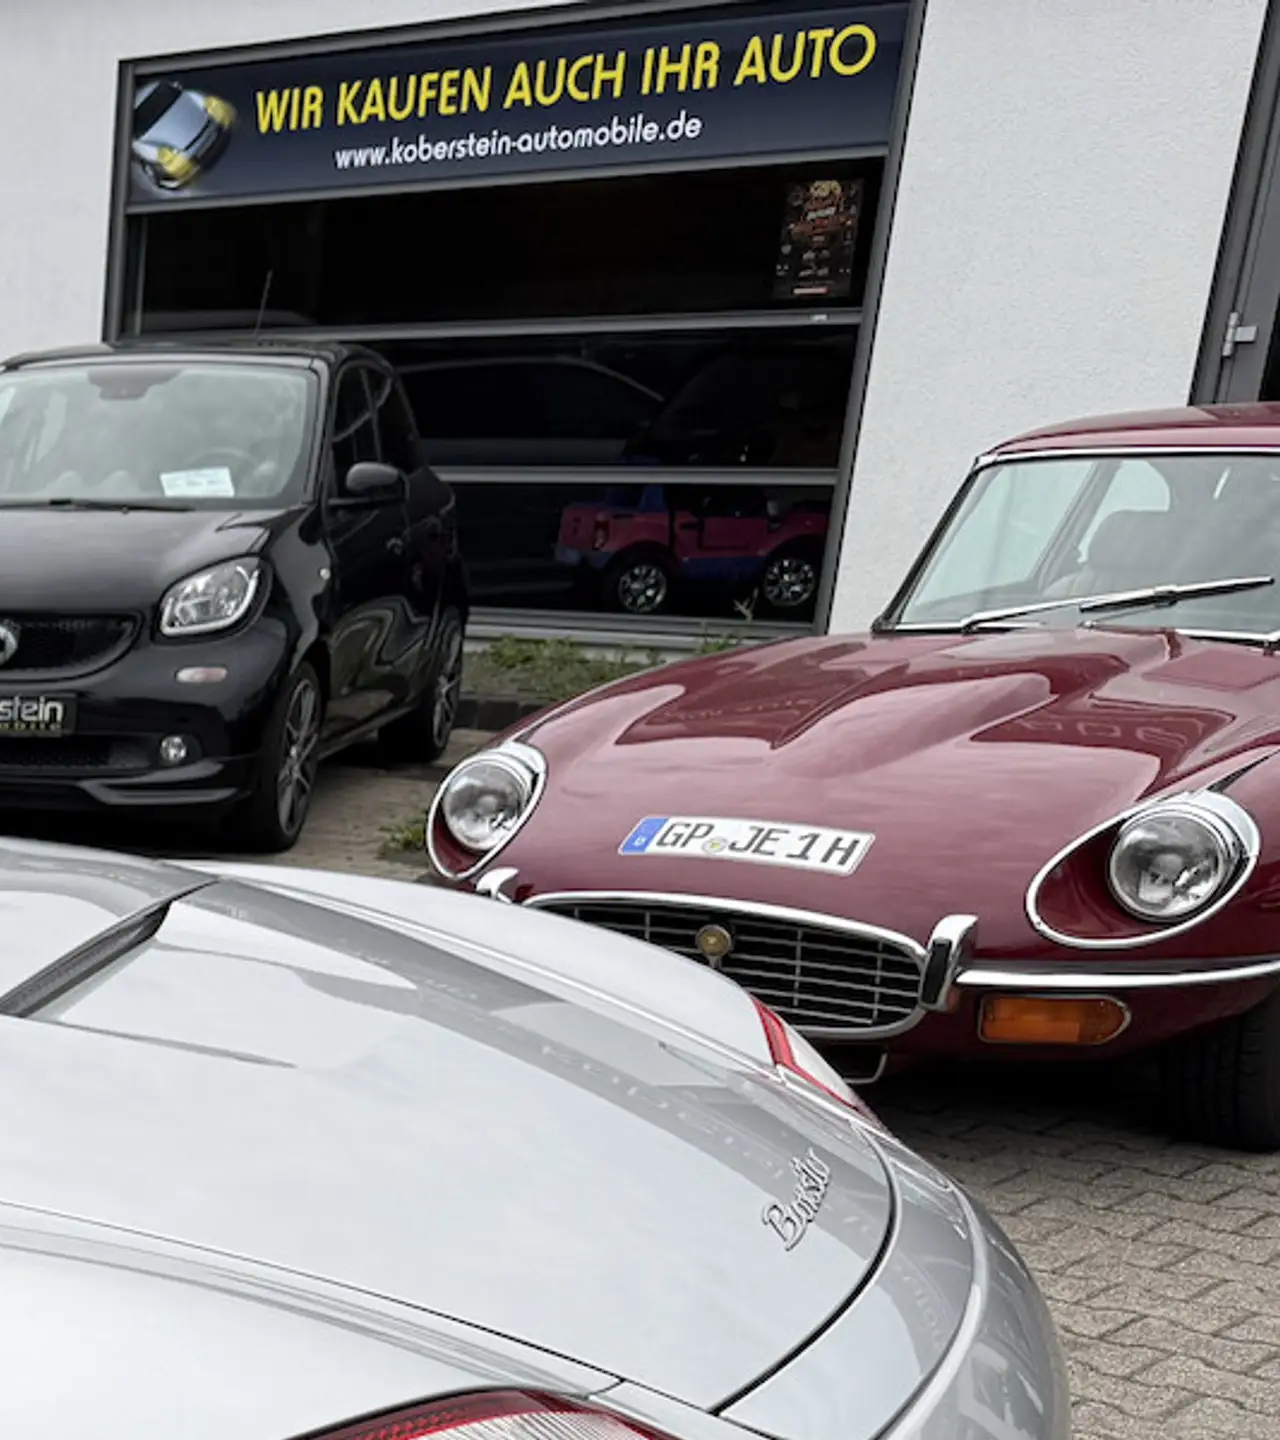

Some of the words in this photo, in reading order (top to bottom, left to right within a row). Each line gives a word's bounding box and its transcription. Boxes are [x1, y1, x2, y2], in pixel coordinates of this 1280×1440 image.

[256, 85, 324, 134] WIR
[336, 65, 492, 126] KAUFEN
[502, 51, 626, 109] AUCH
[640, 41, 721, 95] IHR
[733, 23, 877, 86] AUTO
[334, 109, 703, 169] www.koberstein-automobile.de
[655, 822, 715, 849] GP
